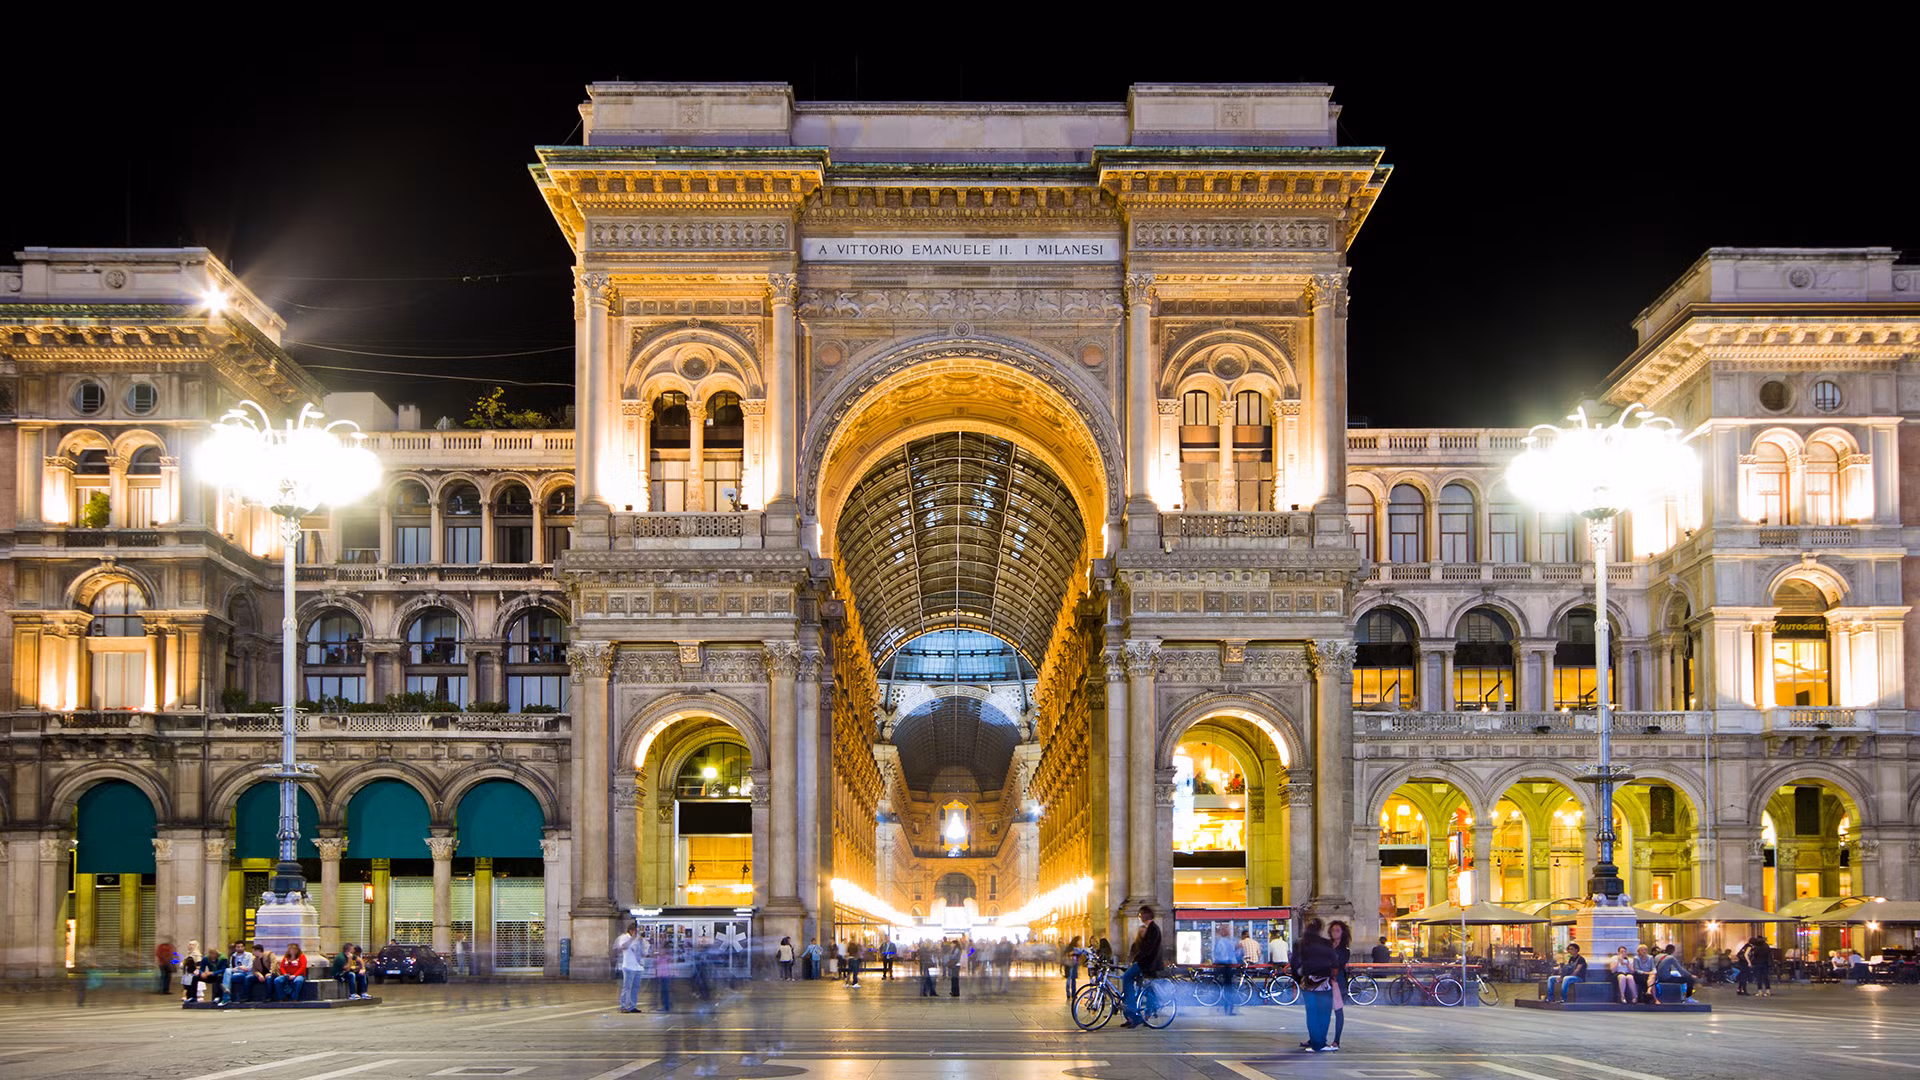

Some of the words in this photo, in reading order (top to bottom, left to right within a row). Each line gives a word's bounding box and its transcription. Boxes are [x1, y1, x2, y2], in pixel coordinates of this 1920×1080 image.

[818, 244, 828, 255] A
[837, 244, 904, 255] VITTORIO
[912, 244, 991, 255] EMANUELE
[1037, 244, 1104, 255] MILANESI
[1780, 623, 1825, 631] AUTOGRILL
